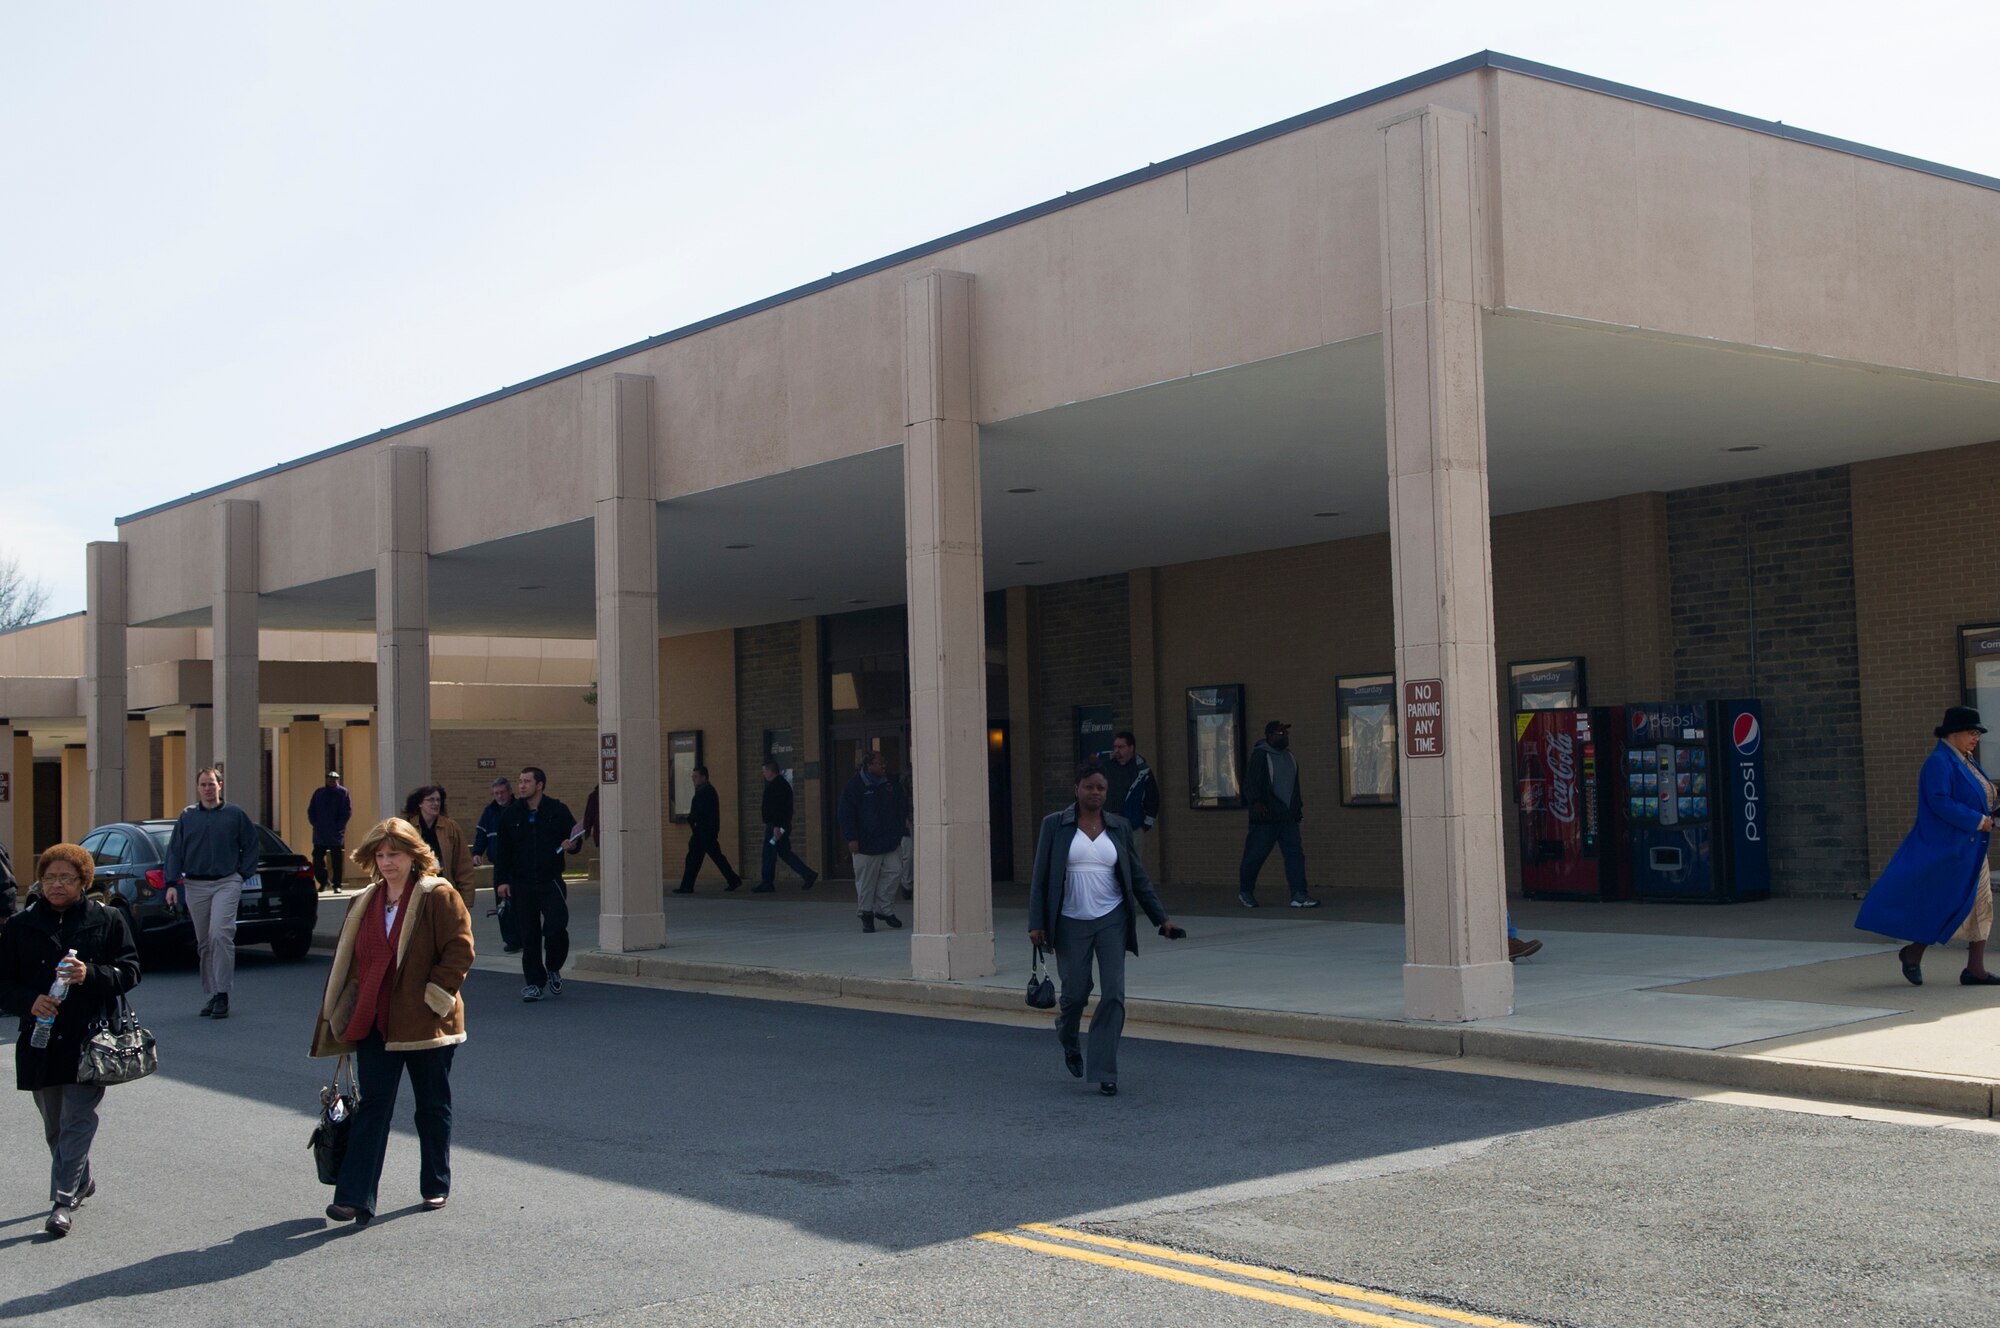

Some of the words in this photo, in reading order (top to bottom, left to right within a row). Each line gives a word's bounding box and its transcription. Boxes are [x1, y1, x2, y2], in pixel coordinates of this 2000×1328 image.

[1531, 672, 1561, 682] Sunday
[1354, 686, 1383, 695] Saturday
[1415, 685, 1431, 700] NO
[1408, 702, 1440, 718] PARKING
[1415, 720, 1434, 735] ANY
[1650, 713, 1694, 730] pepsi
[605, 737, 613, 746] NO
[1414, 738, 1436, 752] TIME
[605, 760, 614, 769] ANY
[1740, 762, 1760, 841] pepsi
